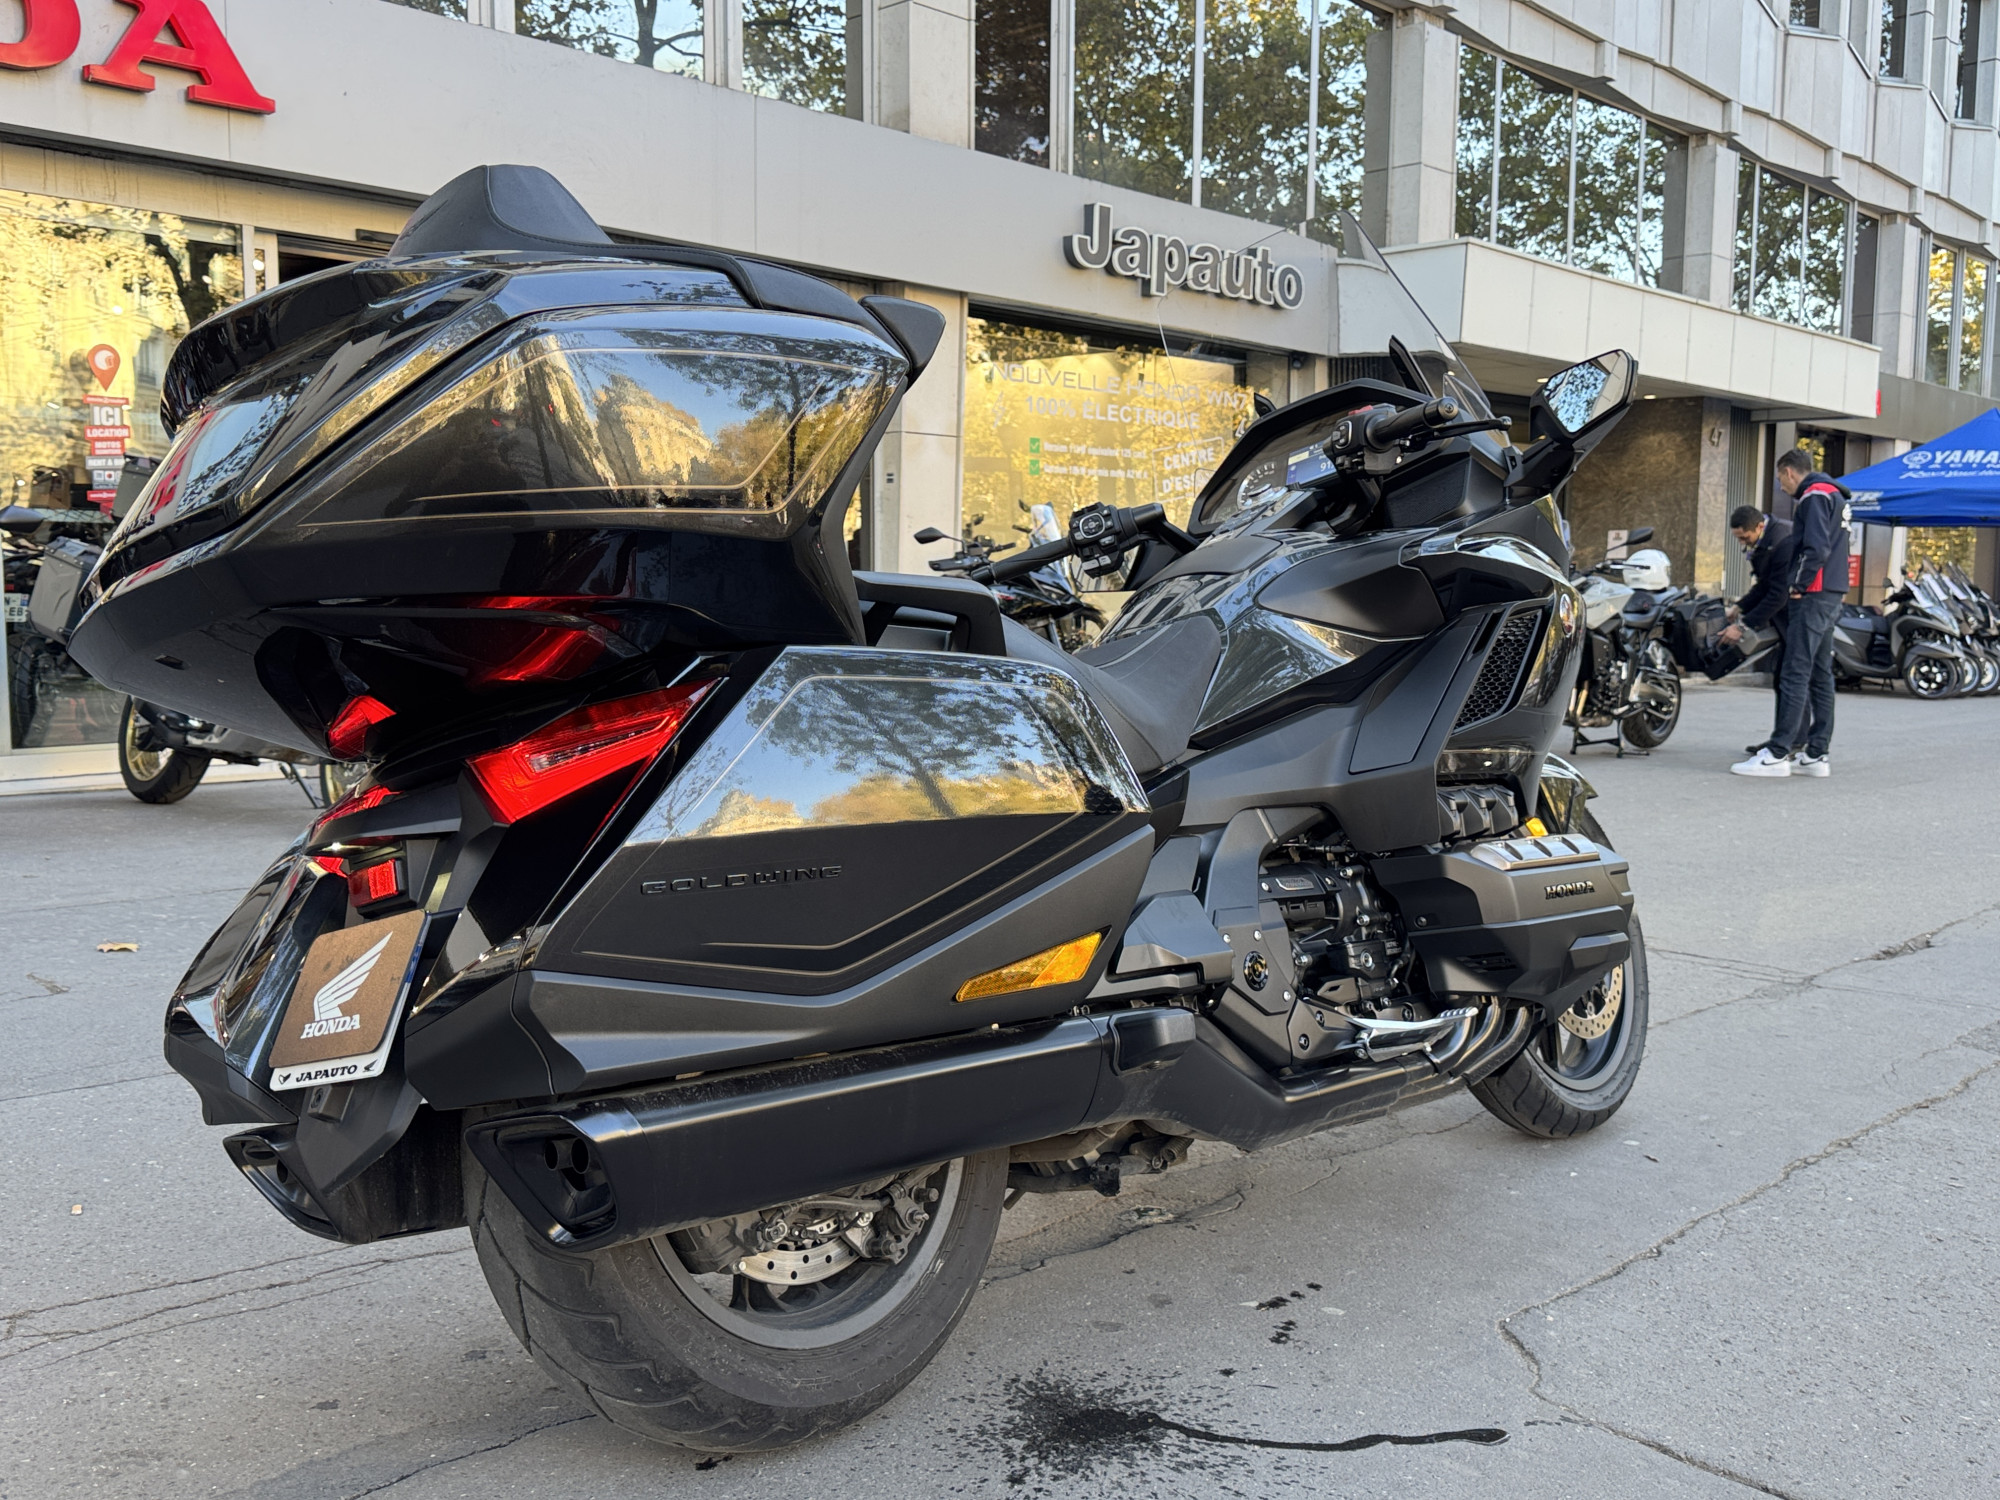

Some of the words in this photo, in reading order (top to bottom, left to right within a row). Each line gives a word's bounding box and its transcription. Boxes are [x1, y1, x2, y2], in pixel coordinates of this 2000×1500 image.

[1063, 202, 1305, 310] Japauto
[992, 362, 1120, 395] NOUVELLE
[93, 406, 121, 426] ICI
[1026, 395, 1076, 418] 100%
[1082, 397, 1200, 430] ÉLECTRIQUE
[86, 427, 129, 438] LOCATION
[1163, 447, 1214, 470] CENTRE
[1934, 449, 2000, 464] YAMA
[640, 865, 843, 895] GOLDWING
[1544, 880, 1596, 900] HONDA
[300, 1014, 361, 1040] HONDA
[296, 1064, 358, 1083] JAPAUTO
